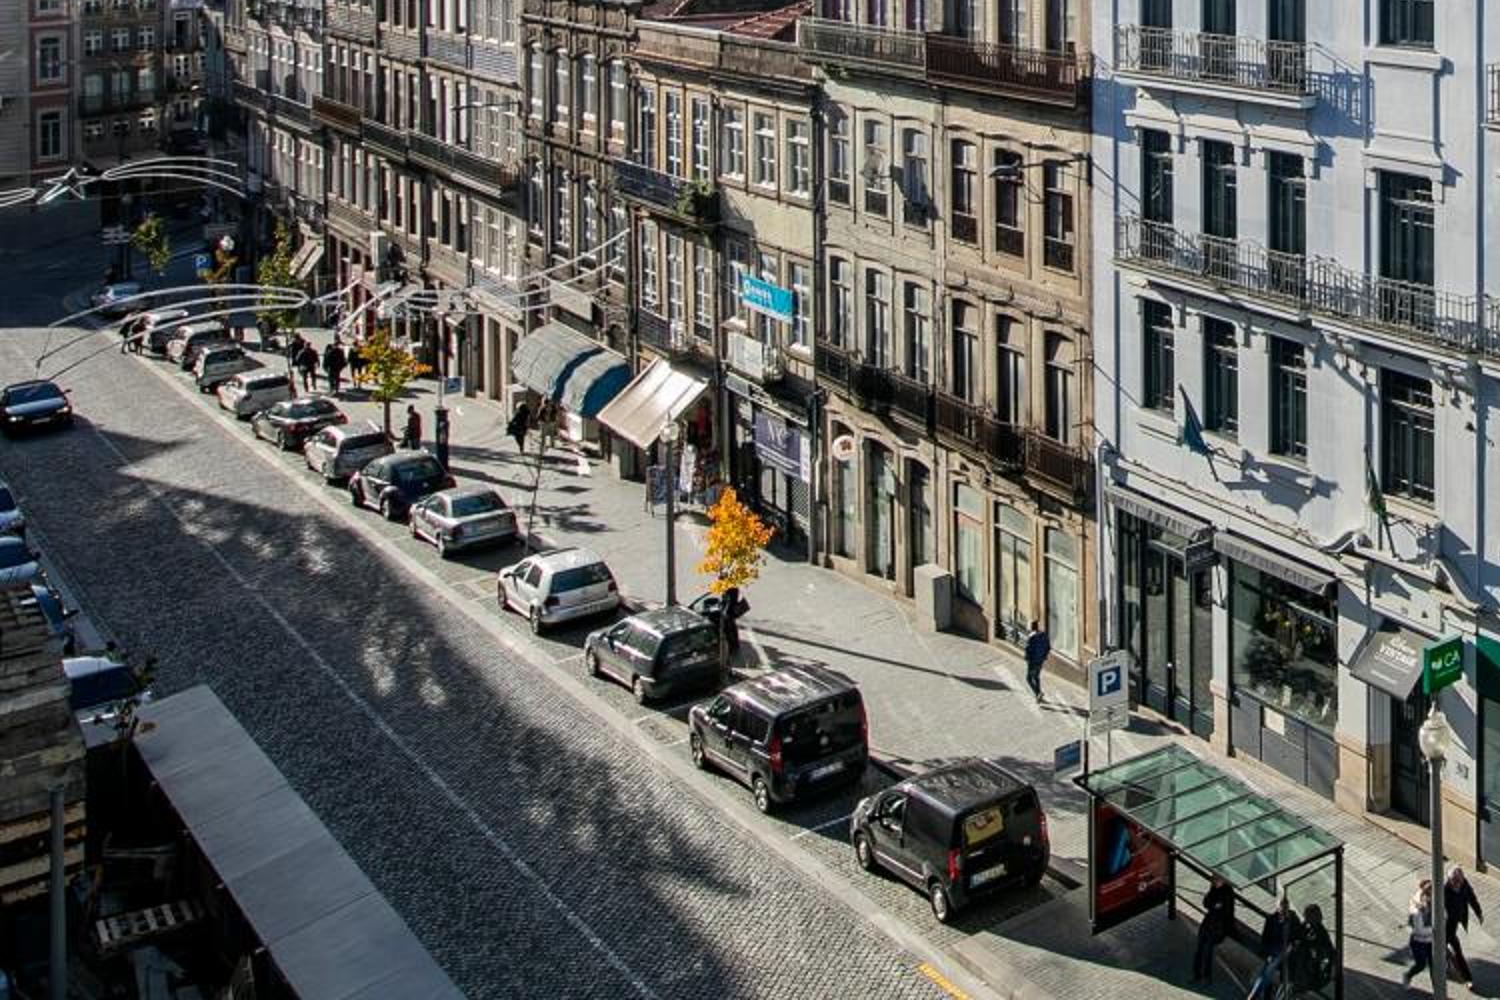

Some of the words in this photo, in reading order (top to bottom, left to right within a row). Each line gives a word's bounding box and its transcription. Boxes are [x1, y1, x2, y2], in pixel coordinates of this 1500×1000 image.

[195, 256, 206, 267] P
[1443, 650, 1461, 667] CA
[1103, 671, 1116, 693] P
